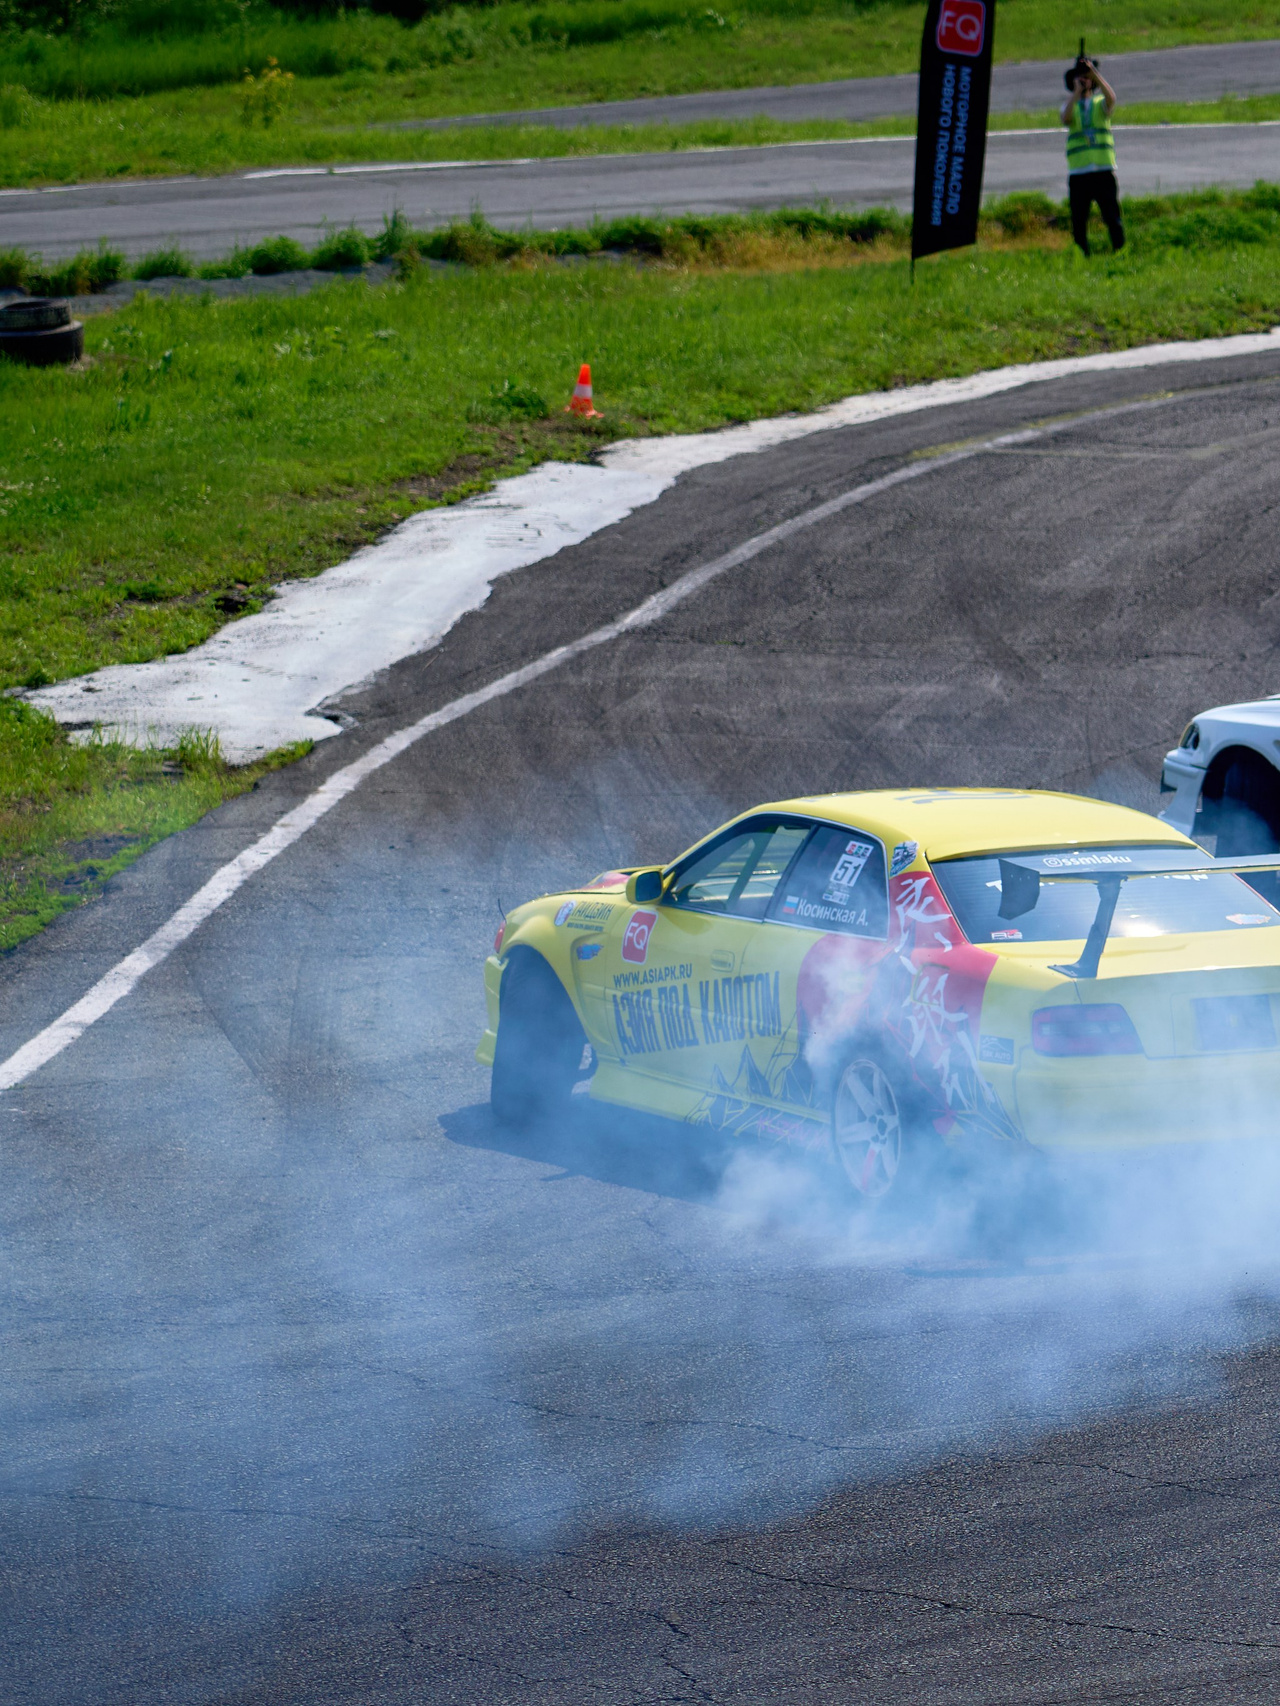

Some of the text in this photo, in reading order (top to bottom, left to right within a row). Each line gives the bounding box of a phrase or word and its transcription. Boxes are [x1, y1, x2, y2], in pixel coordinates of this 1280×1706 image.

[940, 10, 981, 42] FQ
[930, 63, 956, 227] НОВОГО ПОКОЛЕНИЯ
[945, 65, 972, 215] МОТОРНОЕ МАСЛО
[833, 860, 862, 885] 51
[796, 898, 856, 925] Косинская
[856, 908, 869, 927] А.
[624, 921, 649, 951] FQ
[613, 963, 693, 988] WWW.ASIAPK.RU
[612, 970, 782, 1056] АЗИЯ ПОД КАПОТОМ
